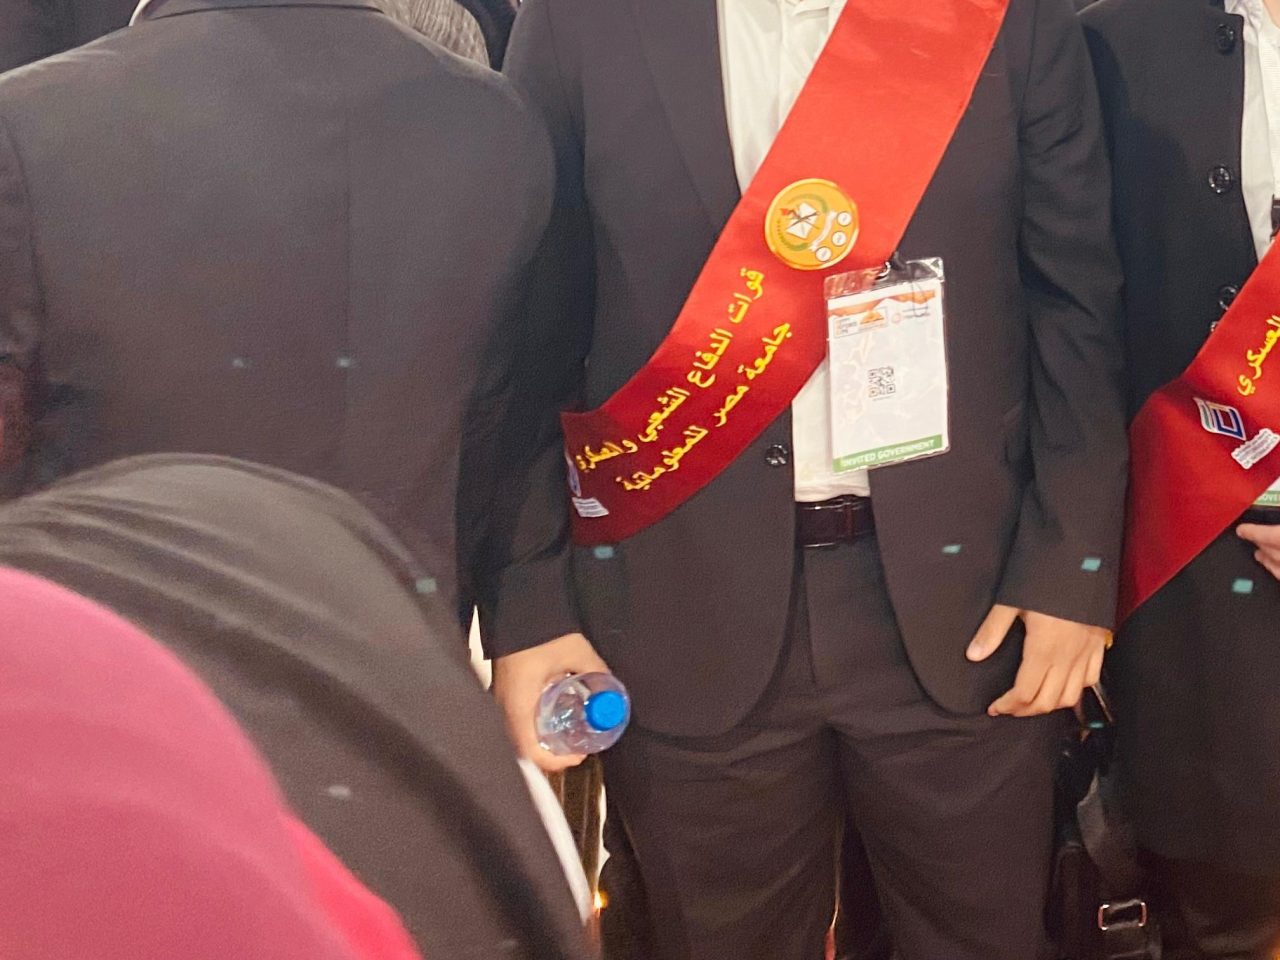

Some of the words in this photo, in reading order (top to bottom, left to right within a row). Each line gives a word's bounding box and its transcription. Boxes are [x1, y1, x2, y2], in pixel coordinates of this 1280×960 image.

[728, 267, 764, 324] قوات
[687, 328, 733, 388] الدفاع
[737, 323, 792, 380] جامعة
[638, 387, 690, 442] الشعبي
[713, 385, 749, 427] مصر
